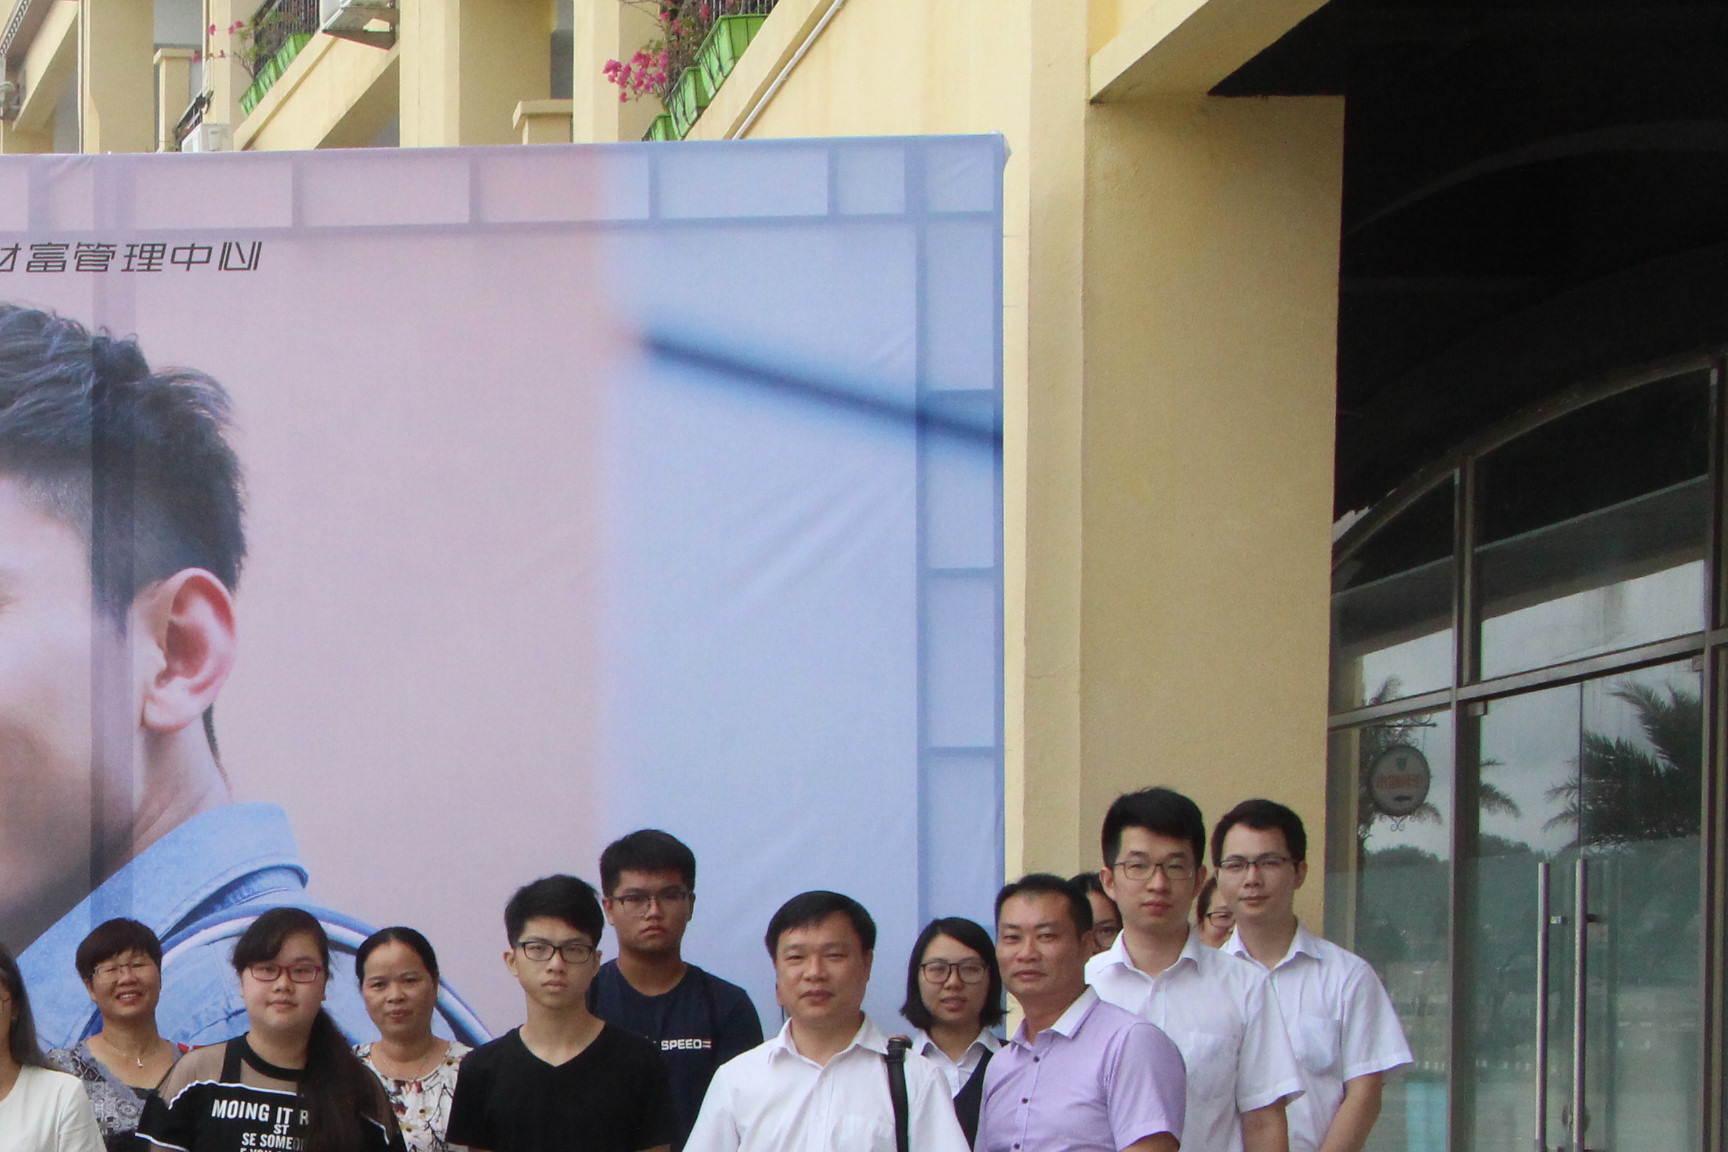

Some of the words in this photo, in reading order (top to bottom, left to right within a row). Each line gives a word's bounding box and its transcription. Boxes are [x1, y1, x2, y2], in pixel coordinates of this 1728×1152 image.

[661, 1039, 702, 1050] SPEED
[210, 1099, 271, 1122] MOING
[276, 1106, 293, 1125] IT
[273, 1124, 290, 1135] ST
[241, 1132, 257, 1147] SE
